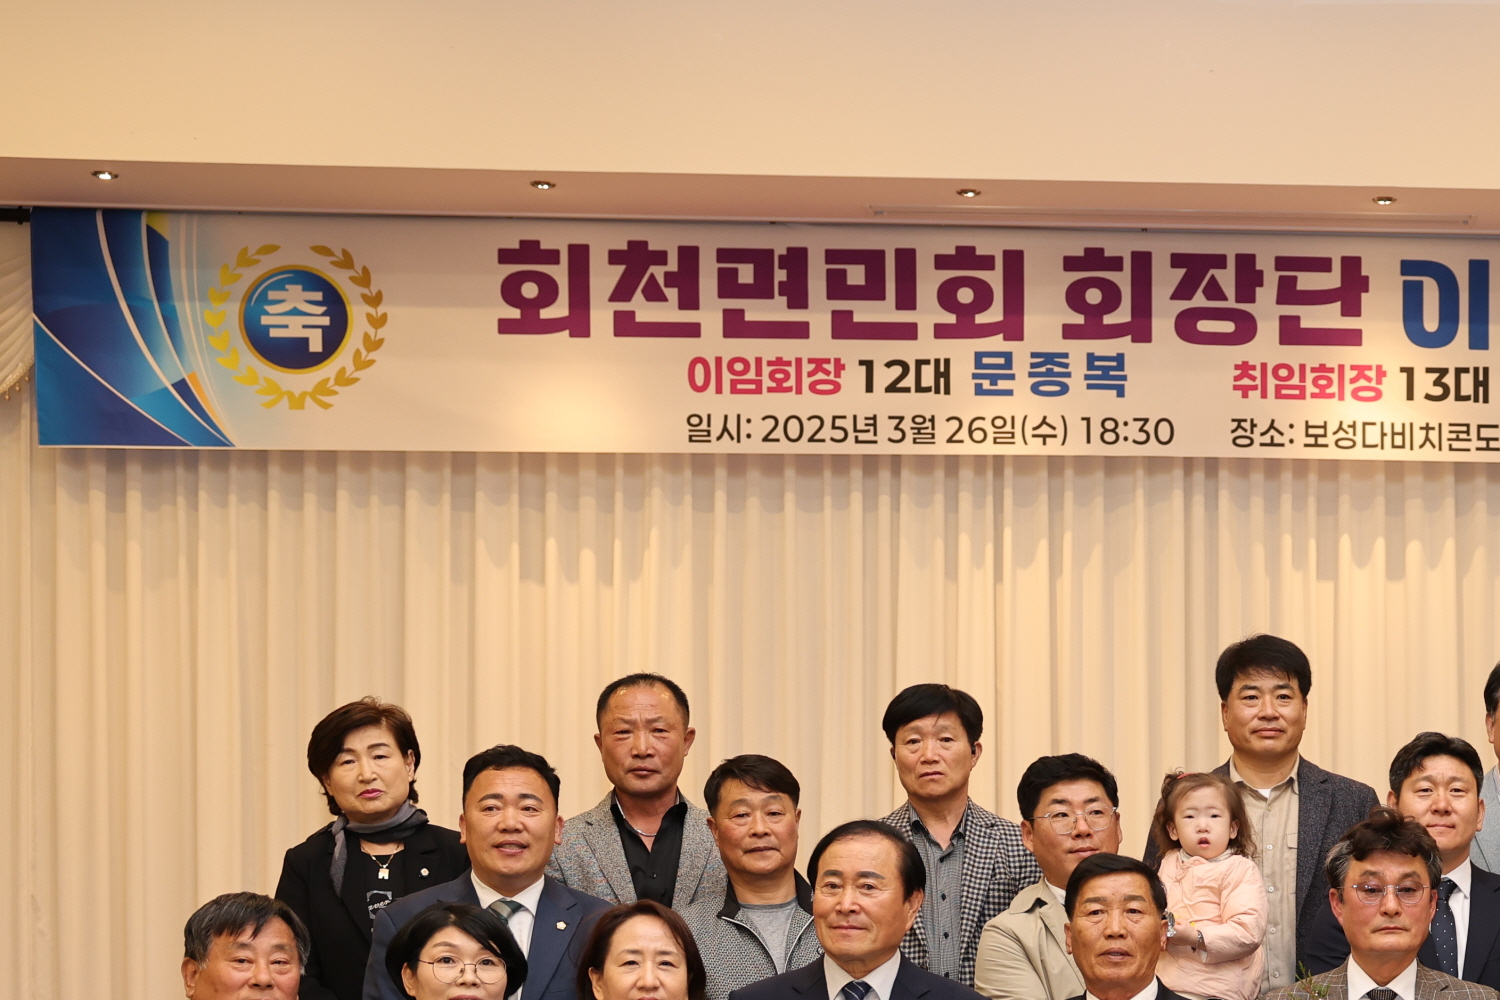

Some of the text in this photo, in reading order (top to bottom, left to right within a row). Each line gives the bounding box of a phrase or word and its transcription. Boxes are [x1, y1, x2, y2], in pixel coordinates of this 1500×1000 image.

[498, 239, 1026, 342] 회천면민회
[1062, 247, 1370, 348] 회장단
[260, 284, 331, 353] 축
[688, 356, 846, 397] 이임회장
[859, 358, 951, 396] 12대
[1232, 361, 1388, 403] 취임회장
[1400, 366, 1490, 405] 13대
[686, 414, 1176, 447] 일시: 2025년 3월 26일(수) 18:30
[1230, 418, 1296, 450] 장소:
